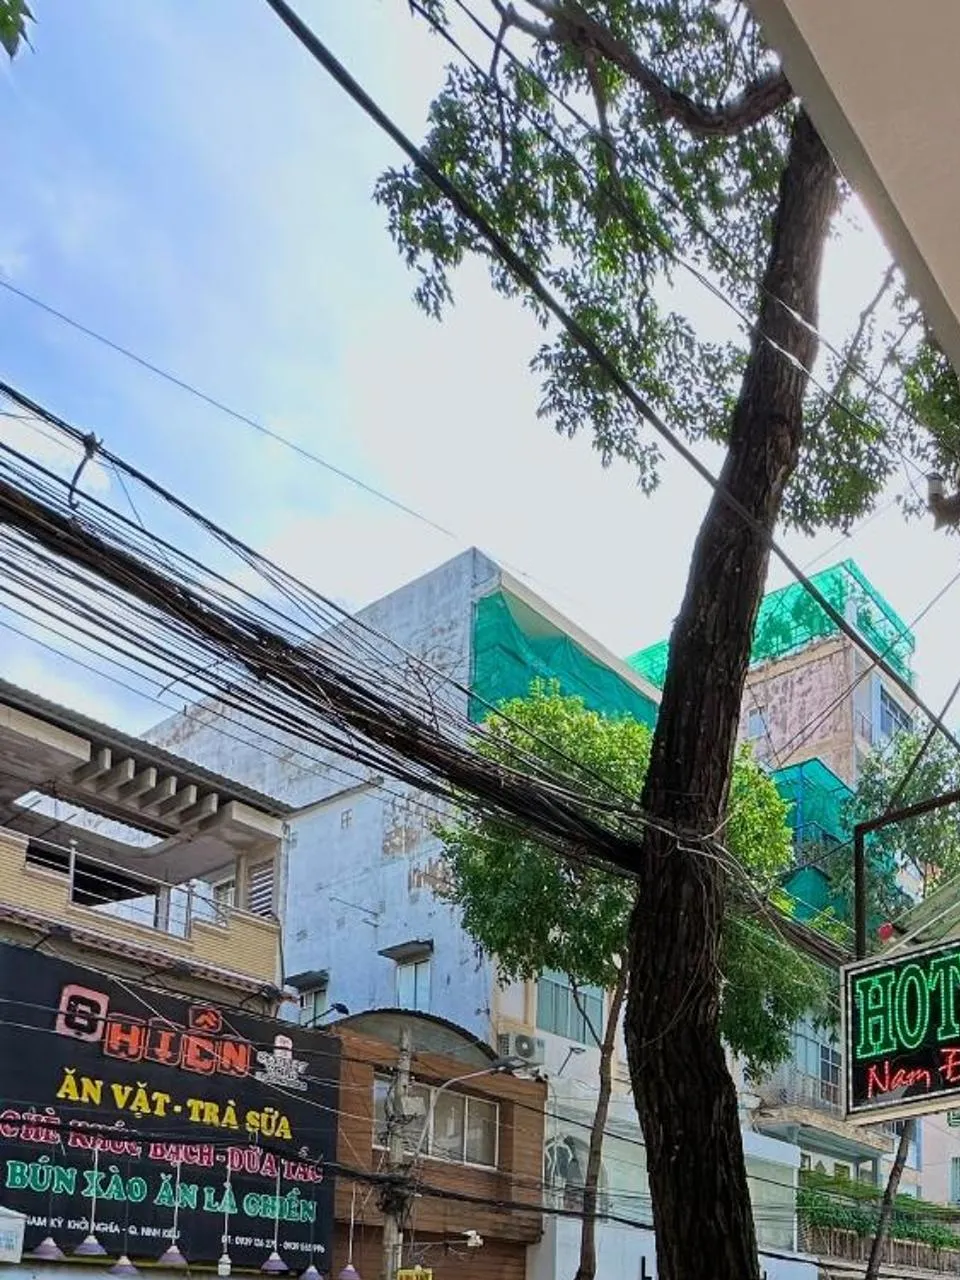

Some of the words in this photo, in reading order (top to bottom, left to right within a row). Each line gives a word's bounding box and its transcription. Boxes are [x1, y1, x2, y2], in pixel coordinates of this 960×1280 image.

[56, 1067, 104, 1105] ĂN
[111, 1082, 170, 1119] VẶT
[187, 1099, 239, 1131] TRÀ
[245, 1107, 293, 1140] SỮA
[866, 1060, 931, 1100] Nam
[5, 1155, 77, 1195] BÚN
[81, 1165, 148, 1202] XÀO
[153, 1173, 199, 1209] ĂN
[203, 1182, 238, 1214] LÀ
